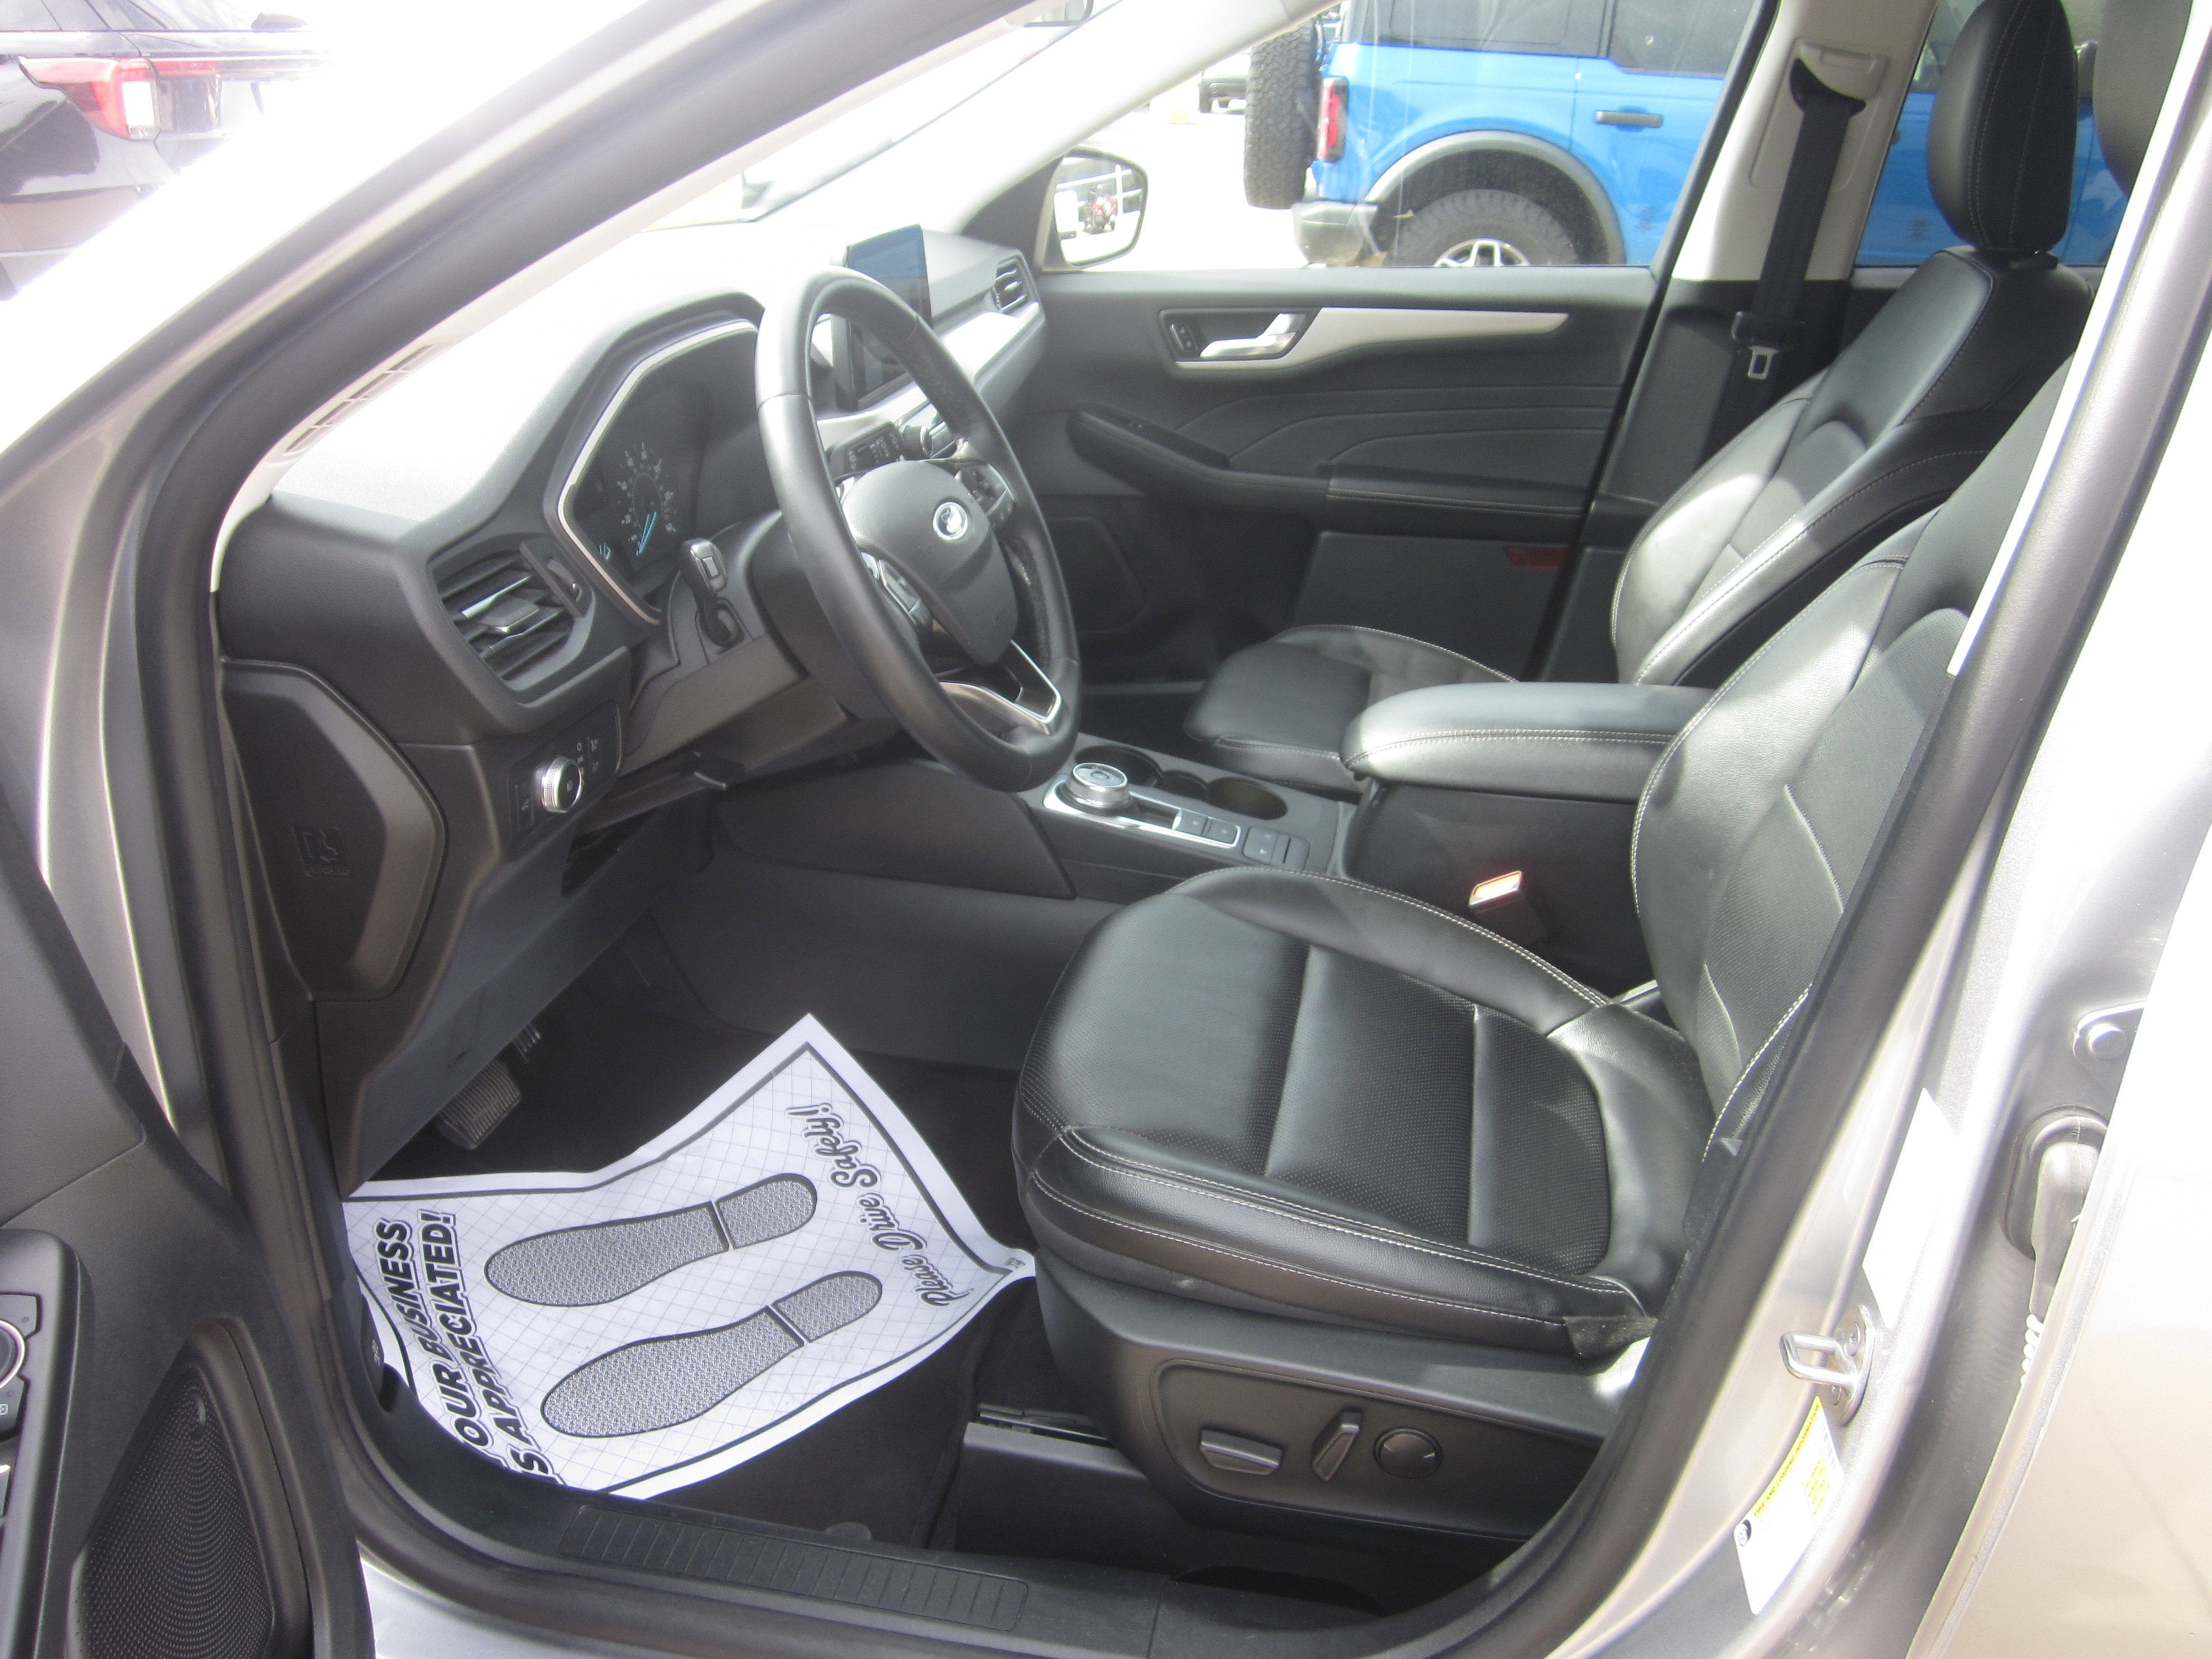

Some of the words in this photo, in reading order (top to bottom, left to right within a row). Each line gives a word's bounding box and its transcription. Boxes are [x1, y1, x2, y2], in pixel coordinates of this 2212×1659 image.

[785, 1103, 881, 1188] Safely!
[858, 1193, 927, 1251] Drive
[374, 1219, 457, 1364] BUSINESS
[418, 1210, 535, 1448] APPRECIATED!
[904, 1255, 974, 1307] Please
[430, 1361, 498, 1460] OUR
[1753, 1501, 1765, 1517] TIRE
[1766, 1486, 1776, 1501] AND
[1776, 1454, 1795, 1486] LOADING
[1795, 1403, 1819, 1453] INFORMATION
